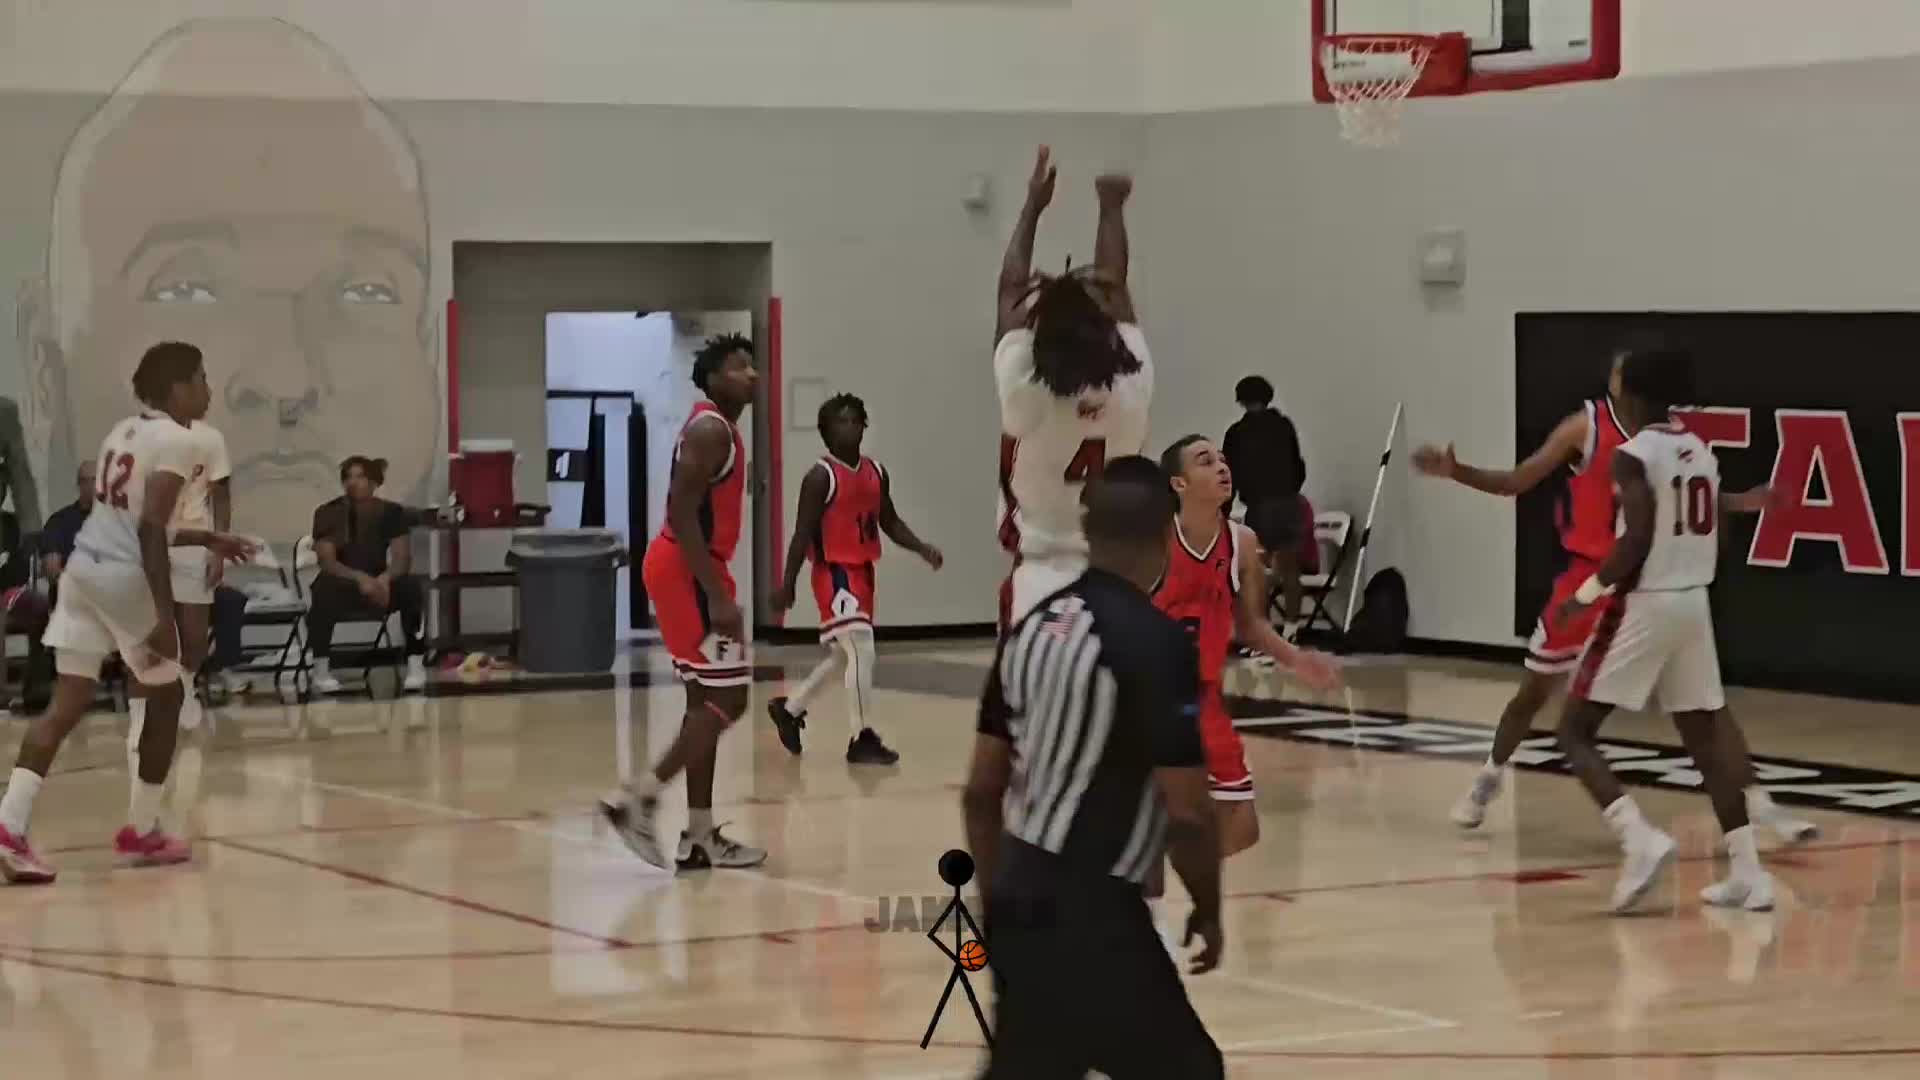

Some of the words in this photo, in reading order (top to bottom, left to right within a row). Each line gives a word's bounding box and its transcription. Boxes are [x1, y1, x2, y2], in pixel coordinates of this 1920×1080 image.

[96, 449, 135, 510] 12
[1064, 437, 1106, 492] 4
[1671, 475, 1713, 537] 10
[716, 640, 729, 661] F
